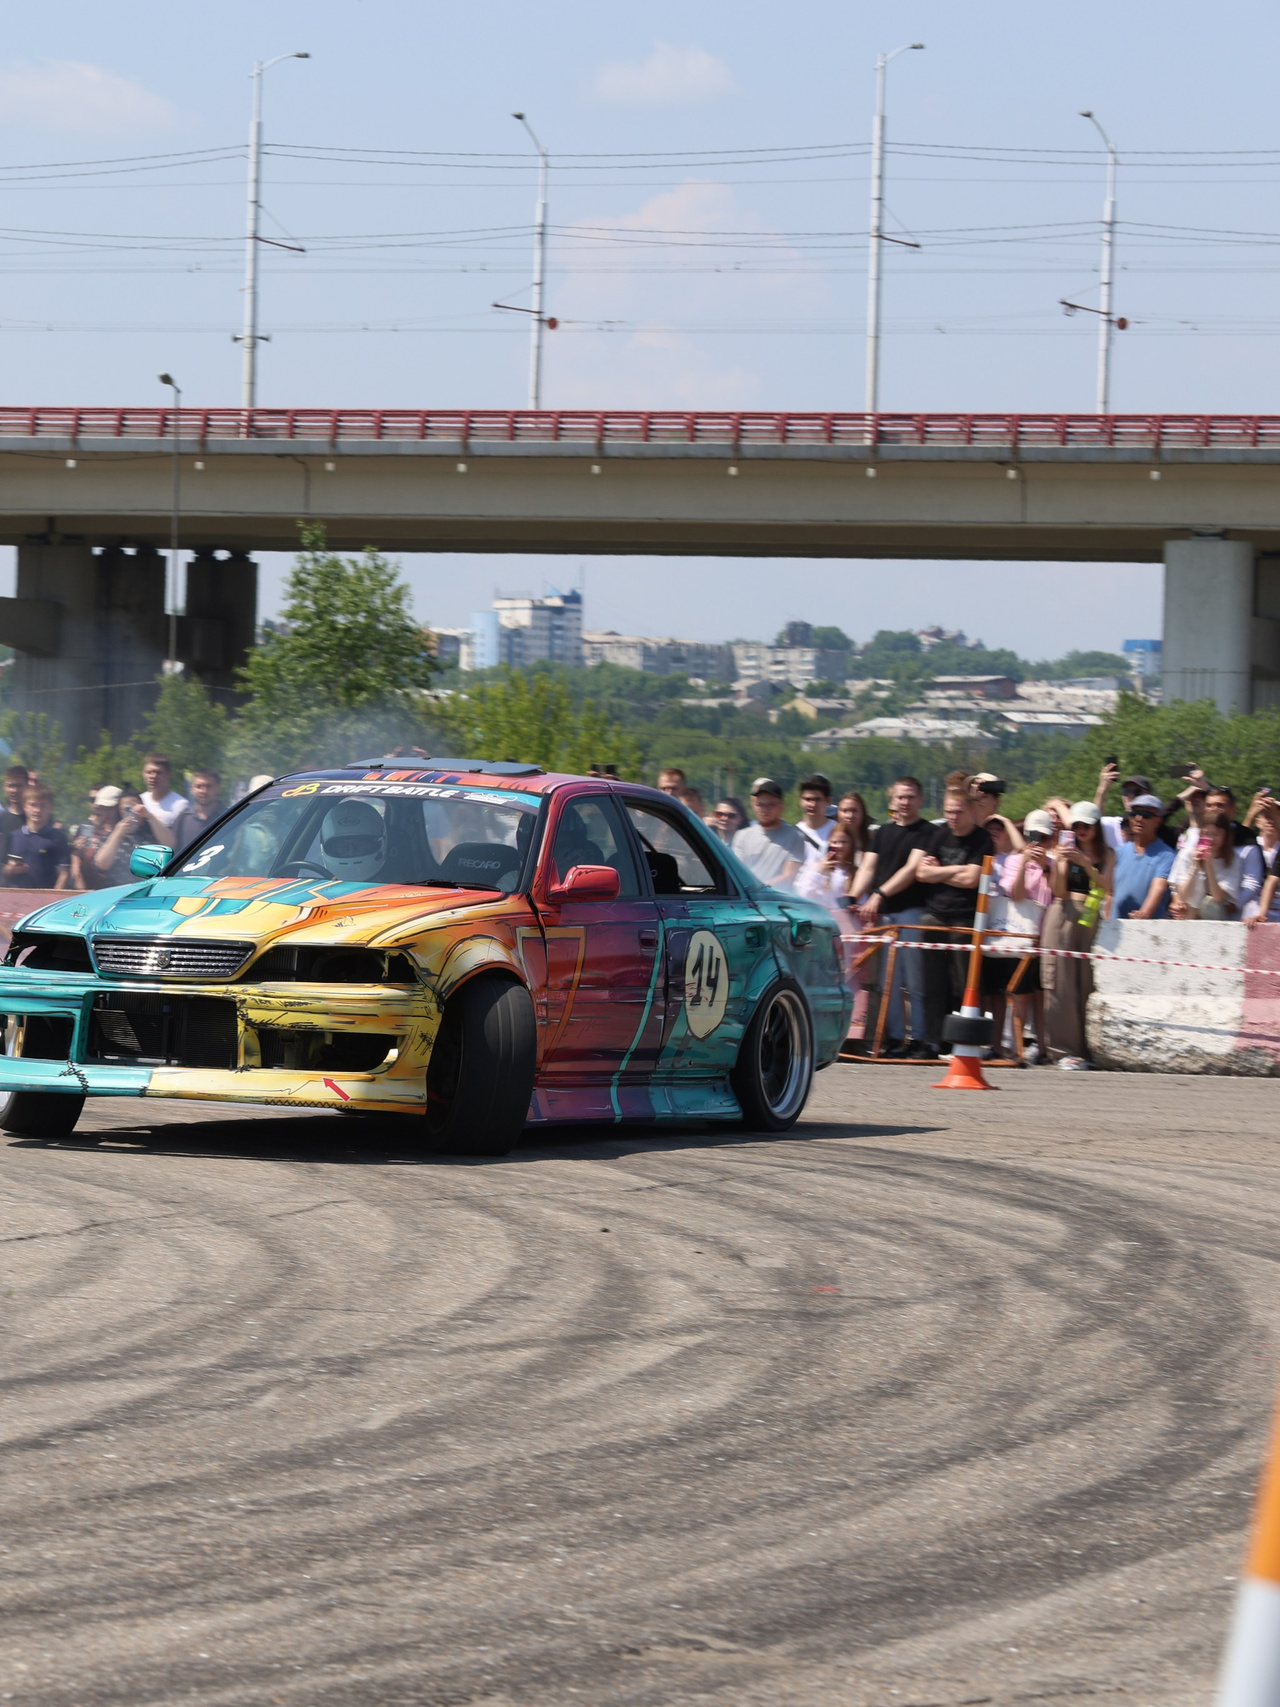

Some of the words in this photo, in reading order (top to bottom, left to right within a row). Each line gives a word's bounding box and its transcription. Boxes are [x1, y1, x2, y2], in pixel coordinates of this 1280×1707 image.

[320, 785, 381, 795] DRIFT
[381, 786, 460, 799] BATTLE
[182, 844, 225, 873] 3
[458, 858, 501, 870] RECARO
[690, 943, 721, 1008] 14
